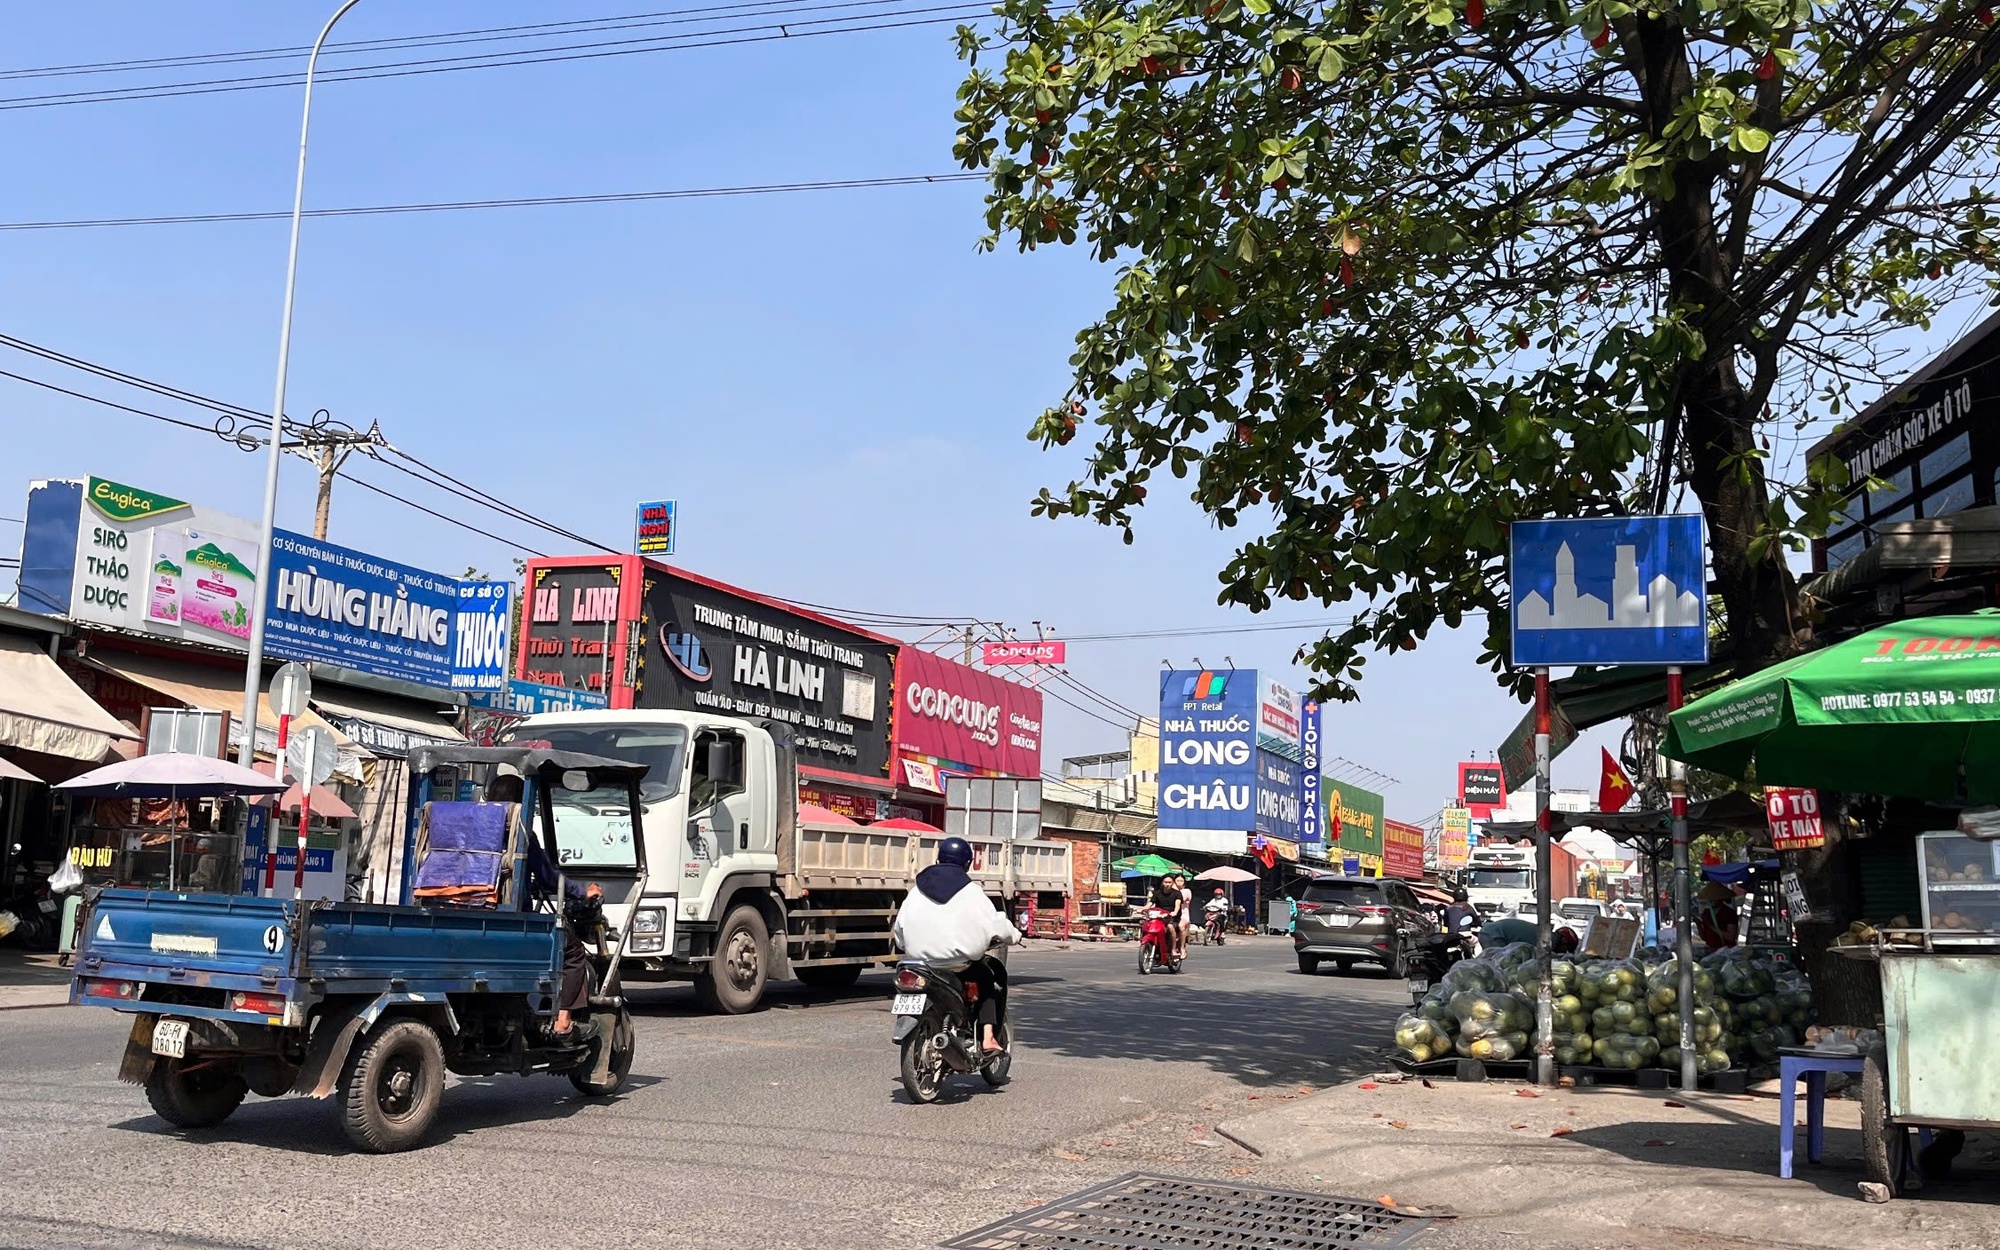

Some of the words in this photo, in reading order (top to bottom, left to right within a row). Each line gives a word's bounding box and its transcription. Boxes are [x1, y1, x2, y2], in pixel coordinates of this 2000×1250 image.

[1904, 413, 1926, 450] SÓC
[1927, 401, 1942, 436] XE
[1944, 388, 1952, 424] Ô
[1954, 377, 1972, 418] TÔ
[94, 482, 151, 512] Eugica
[93, 527, 128, 550] SIRÔ
[86, 555, 129, 580] THẢO
[273, 537, 284, 549] CƠ
[284, 538, 296, 552] SỞ
[295, 543, 321, 560] CHUYÊN
[322, 550, 335, 564] BÁN
[345, 556, 366, 572] THUỐC
[366, 564, 384, 577] DƯỢC
[385, 568, 398, 581] LIỆU
[404, 574, 424, 588] THUỐC
[84, 585, 128, 613] DƯỢC
[276, 565, 366, 628] HÙNG
[460, 586, 475, 598] CƠ
[477, 585, 492, 598] SỞ
[533, 581, 559, 622] HÀ
[572, 587, 619, 622] LINH
[300, 625, 316, 636] DƯỢC
[318, 628, 330, 639] LIỆU
[334, 632, 352, 644] THUỐC
[353, 637, 368, 648] DƯỢC
[386, 644, 402, 655] THUỐC
[455, 600, 506, 668] THUỐC
[694, 604, 732, 630] TRUNG
[735, 614, 758, 638] TÂM
[760, 624, 784, 646] MUA
[786, 629, 810, 652] SẮM
[811, 639, 832, 659] THỜI
[834, 646, 864, 668] TRANG
[452, 672, 476, 688] HÙNG
[734, 645, 770, 690] HÀ
[776, 656, 825, 702] LINH
[1184, 702, 1197, 710] FPT
[1821, 694, 1872, 710] HOTLINE:
[1873, 692, 1902, 708] 0977
[1904, 691, 1920, 706] 53
[1922, 690, 1938, 706] 54
[1940, 690, 1955, 706] 54
[1966, 688, 1996, 704] 0937
[736, 699, 754, 714] GIÀY
[756, 703, 770, 717] DÉP
[772, 707, 789, 722] NAM
[790, 710, 802, 724] NỮ
[805, 714, 820, 728] VALI
[824, 718, 835, 732] TÚI
[836, 721, 854, 736] XÁCH
[1165, 716, 1196, 732] NHÀ
[1199, 714, 1250, 732] THUỐC
[345, 724, 360, 742] CƠ
[362, 727, 374, 744] SỞ
[376, 729, 406, 750] THUỐC
[1164, 740, 1250, 766] LONG
[1164, 778, 1250, 810] CHÂU
[1304, 775, 1317, 834] CHÂU
[1465, 786, 1482, 795] ĐIỆN
[1484, 786, 1500, 794] MÁY
[1770, 792, 1784, 816] Ô
[1788, 790, 1816, 814] TÔ
[1256, 787, 1278, 818] LONG
[1280, 792, 1300, 824] CHÂU
[1772, 820, 1790, 838] XE
[1792, 815, 1822, 837] MÁY
[71, 844, 94, 870] ĐẬU
[268, 926, 278, 954] 9
